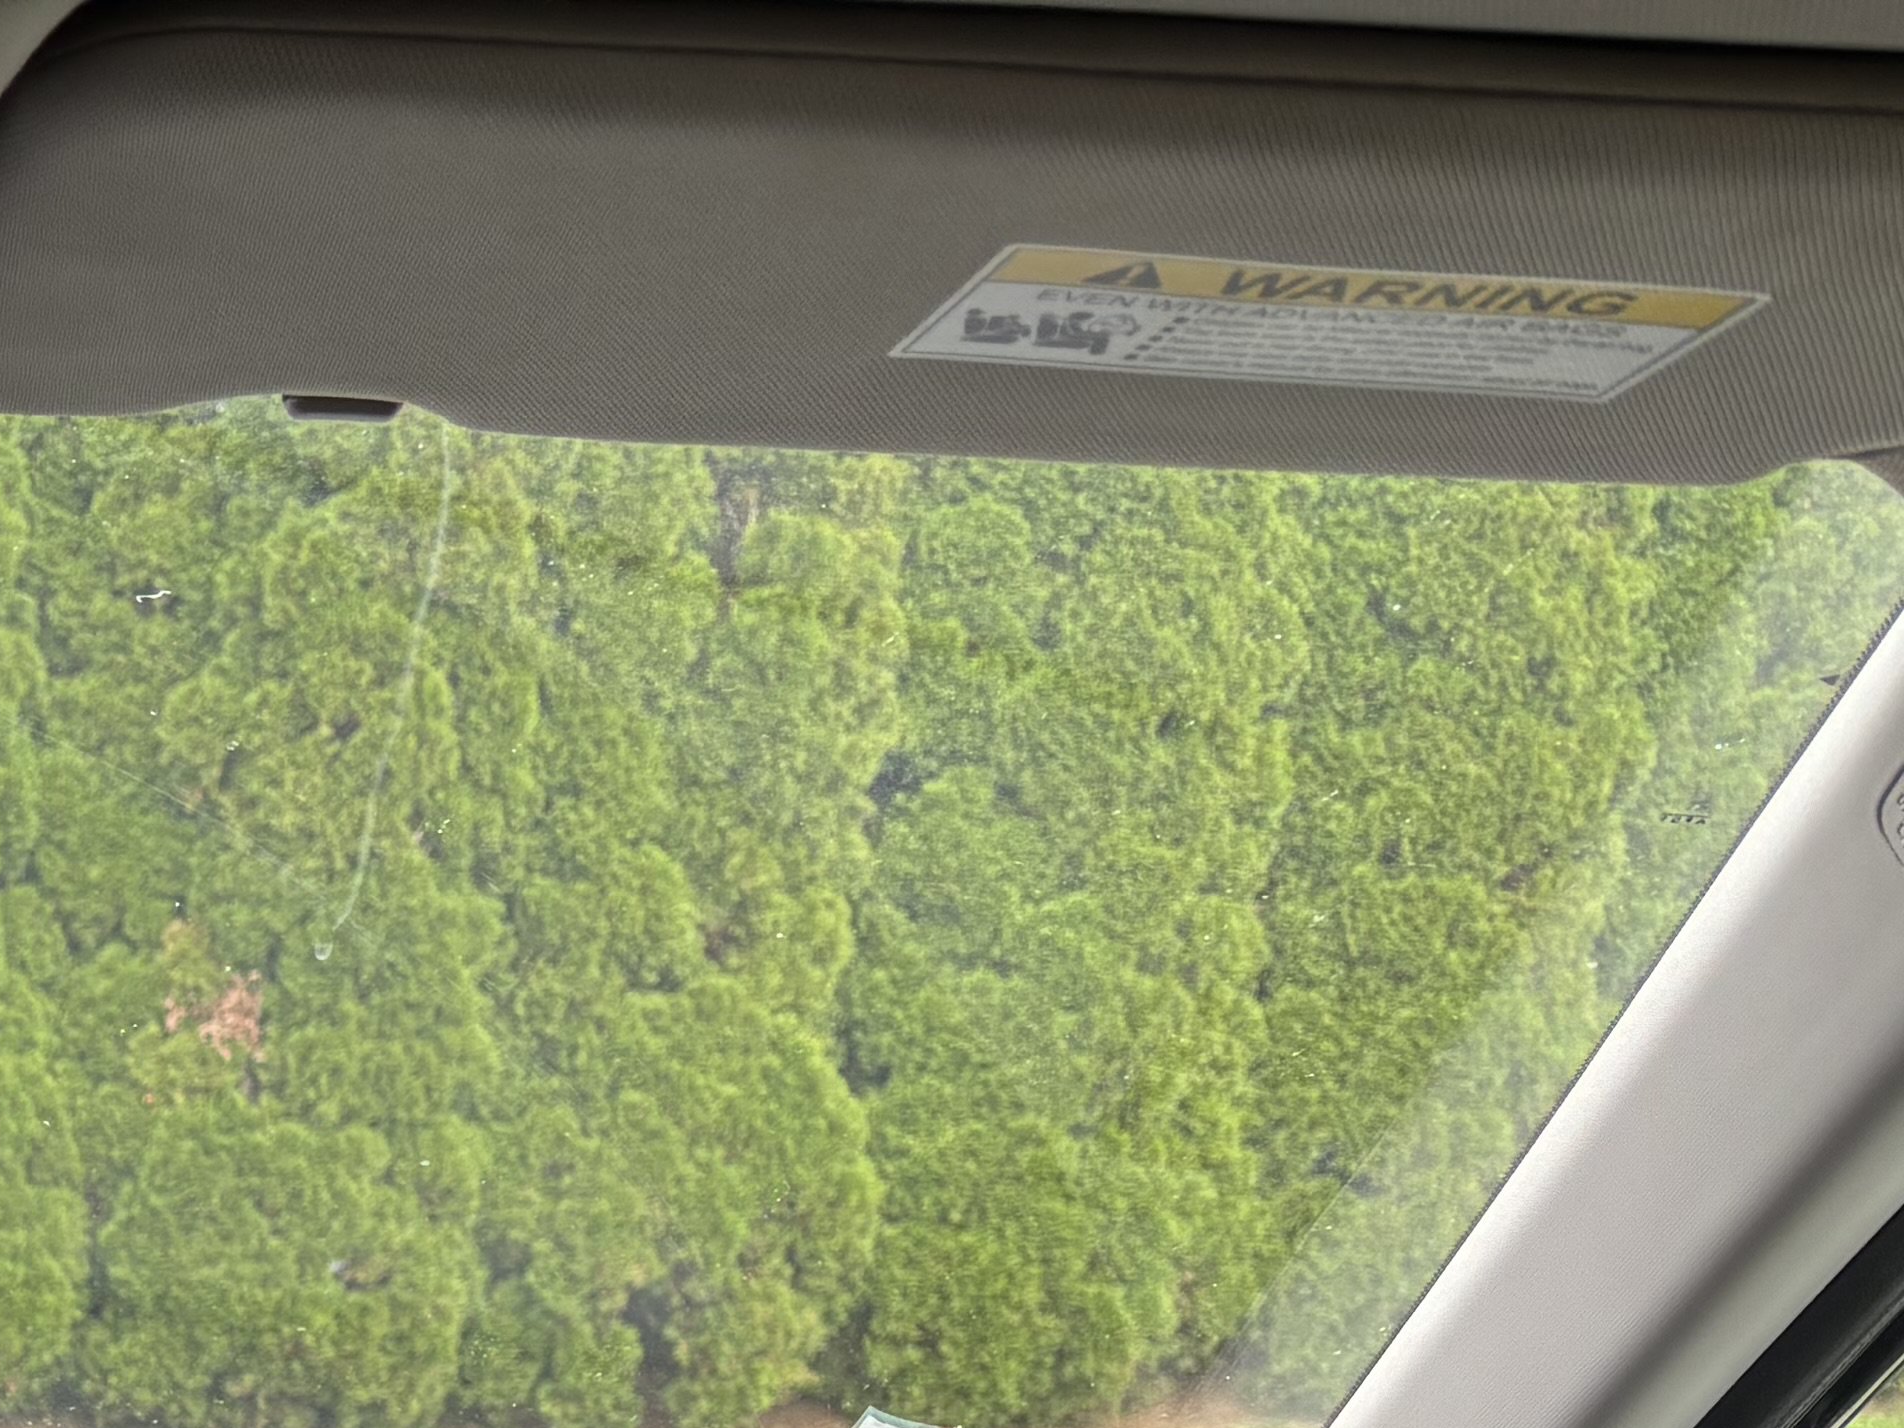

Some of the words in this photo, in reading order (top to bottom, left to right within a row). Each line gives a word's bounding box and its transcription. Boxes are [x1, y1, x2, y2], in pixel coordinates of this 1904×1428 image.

[1036, 289, 1140, 308] EVEN
[1147, 297, 1239, 316] WITH
[1219, 267, 1639, 317] WARNING
